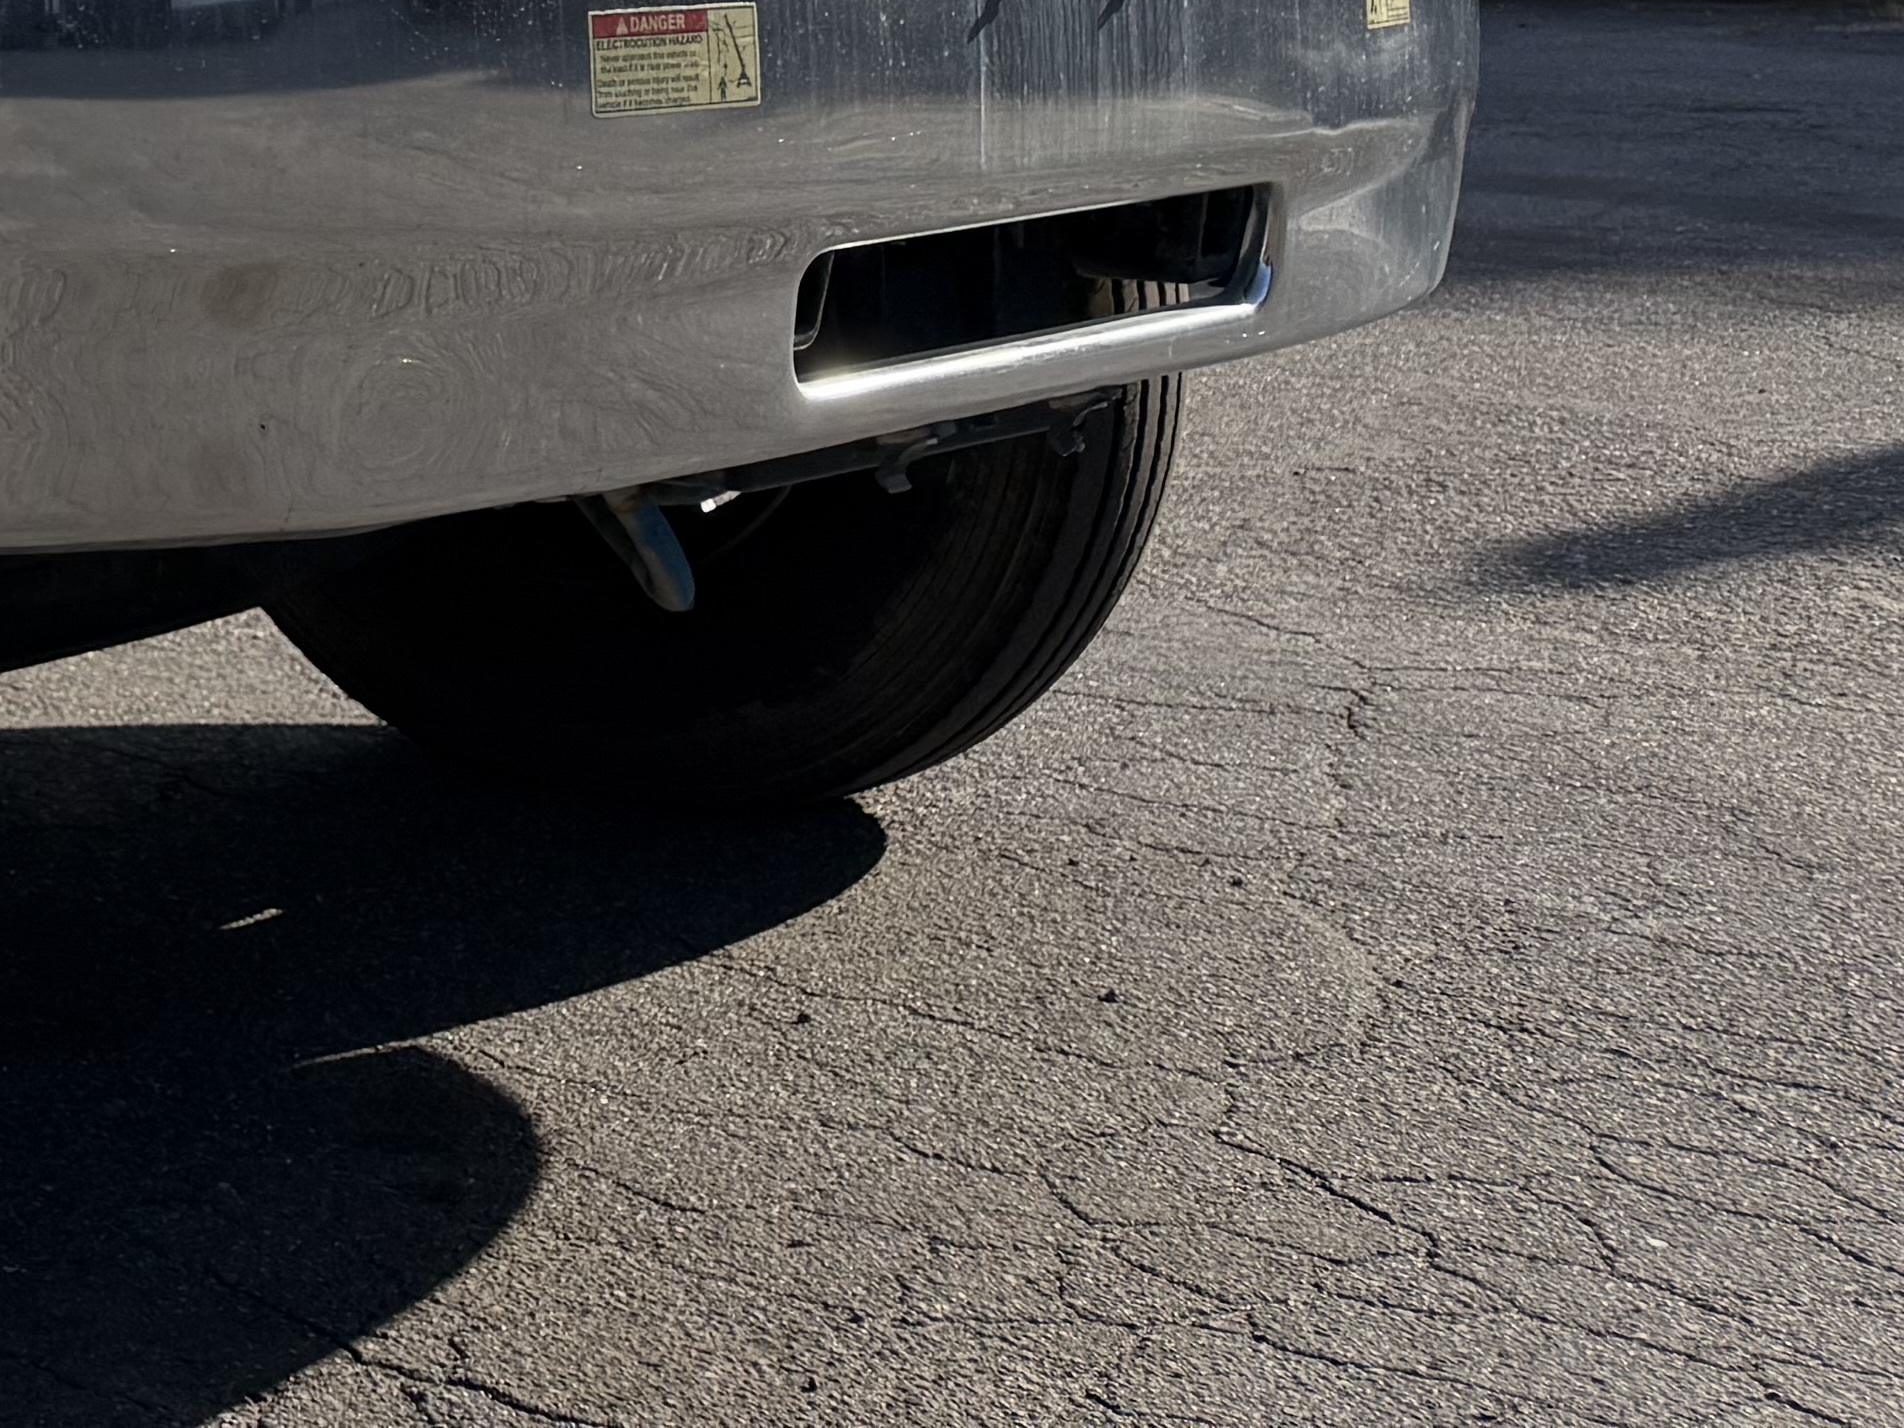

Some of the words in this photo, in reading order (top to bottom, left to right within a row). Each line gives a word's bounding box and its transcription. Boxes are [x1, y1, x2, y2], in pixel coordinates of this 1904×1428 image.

[630, 13, 686, 32] DANGER
[596, 37, 667, 51] ELECTROCUTION
[669, 34, 703, 46] HAZARD
